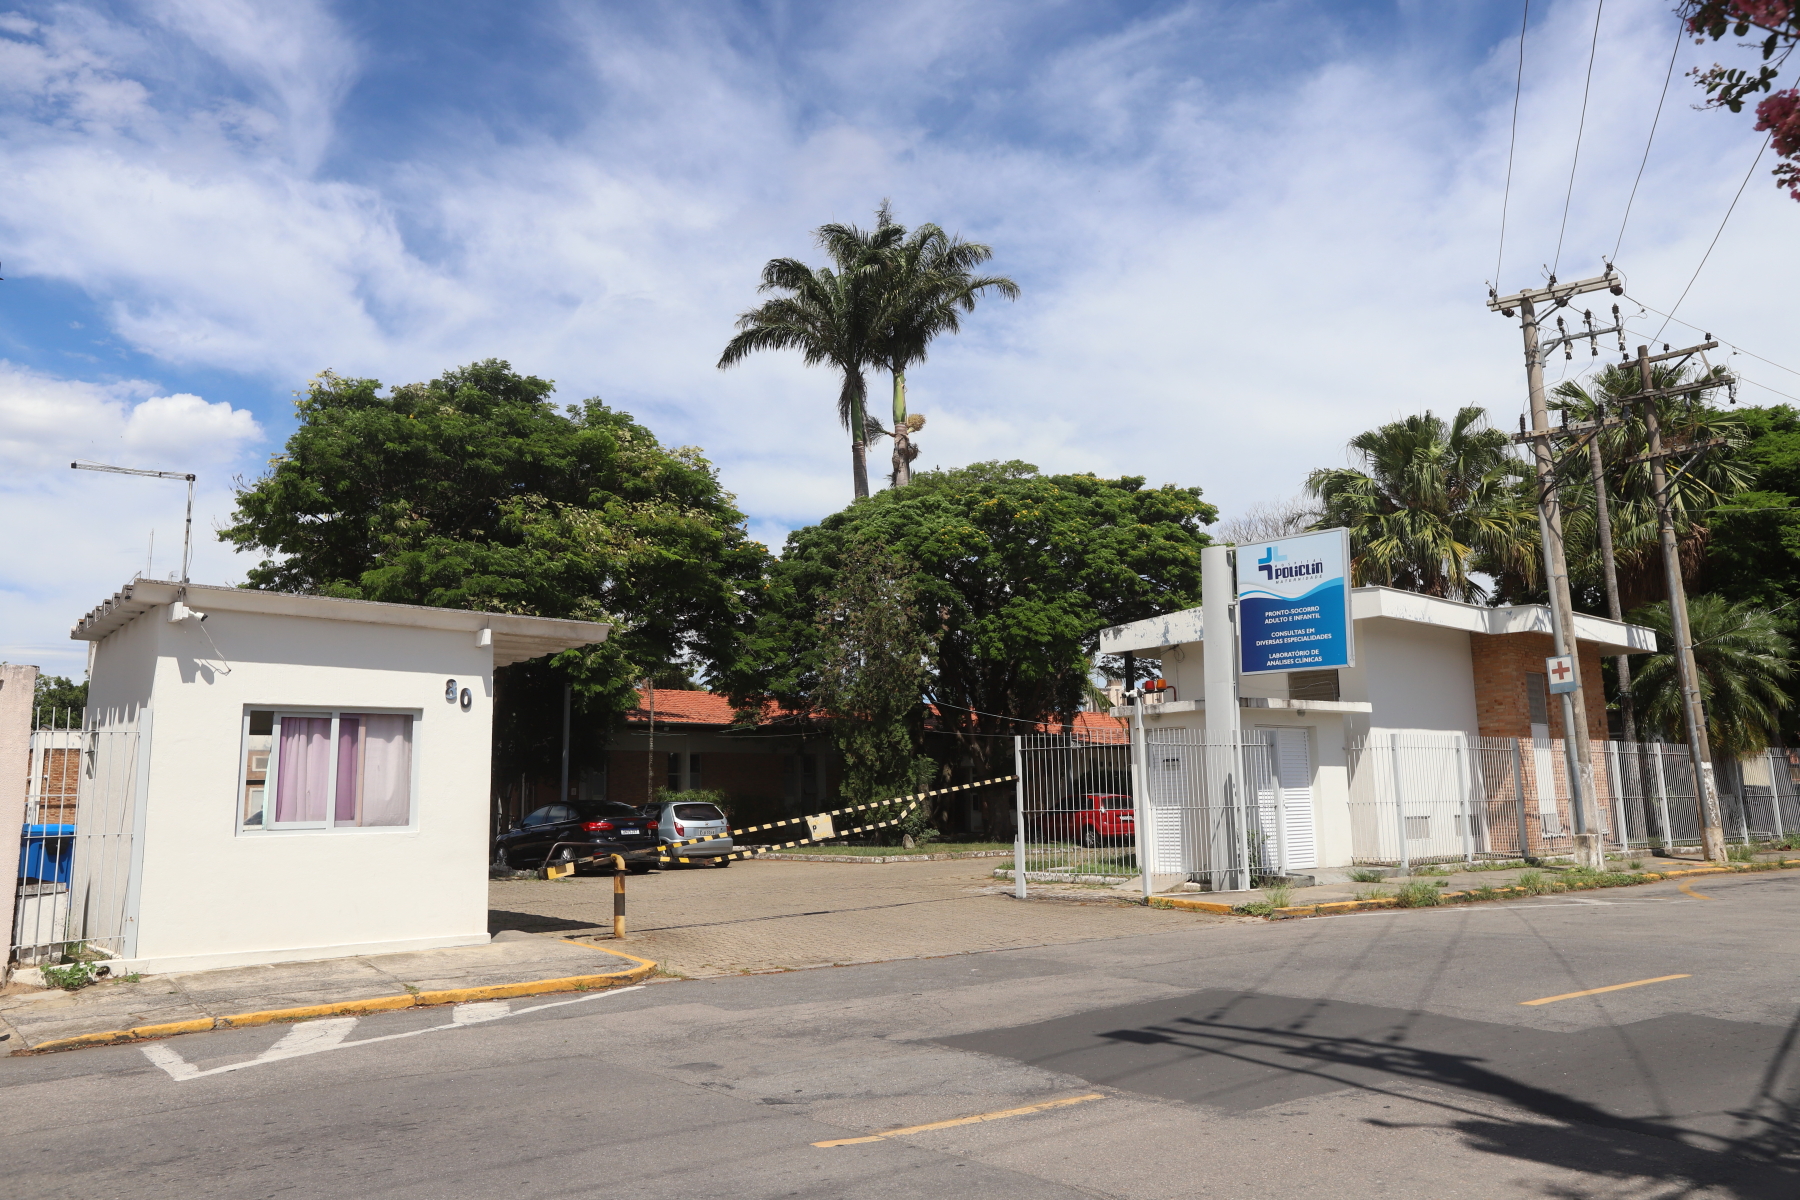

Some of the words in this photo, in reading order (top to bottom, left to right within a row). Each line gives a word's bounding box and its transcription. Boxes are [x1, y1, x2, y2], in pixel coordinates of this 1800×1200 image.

[1275, 575, 1322, 584] MATERNIDADE
[1265, 606, 1319, 617] PRONTO-SOCORRO
[1271, 629, 1305, 638] CONSULTAS
[1284, 633, 1332, 644] ESPECIALIDADES
[1269, 650, 1310, 658] LABORATÓRIO
